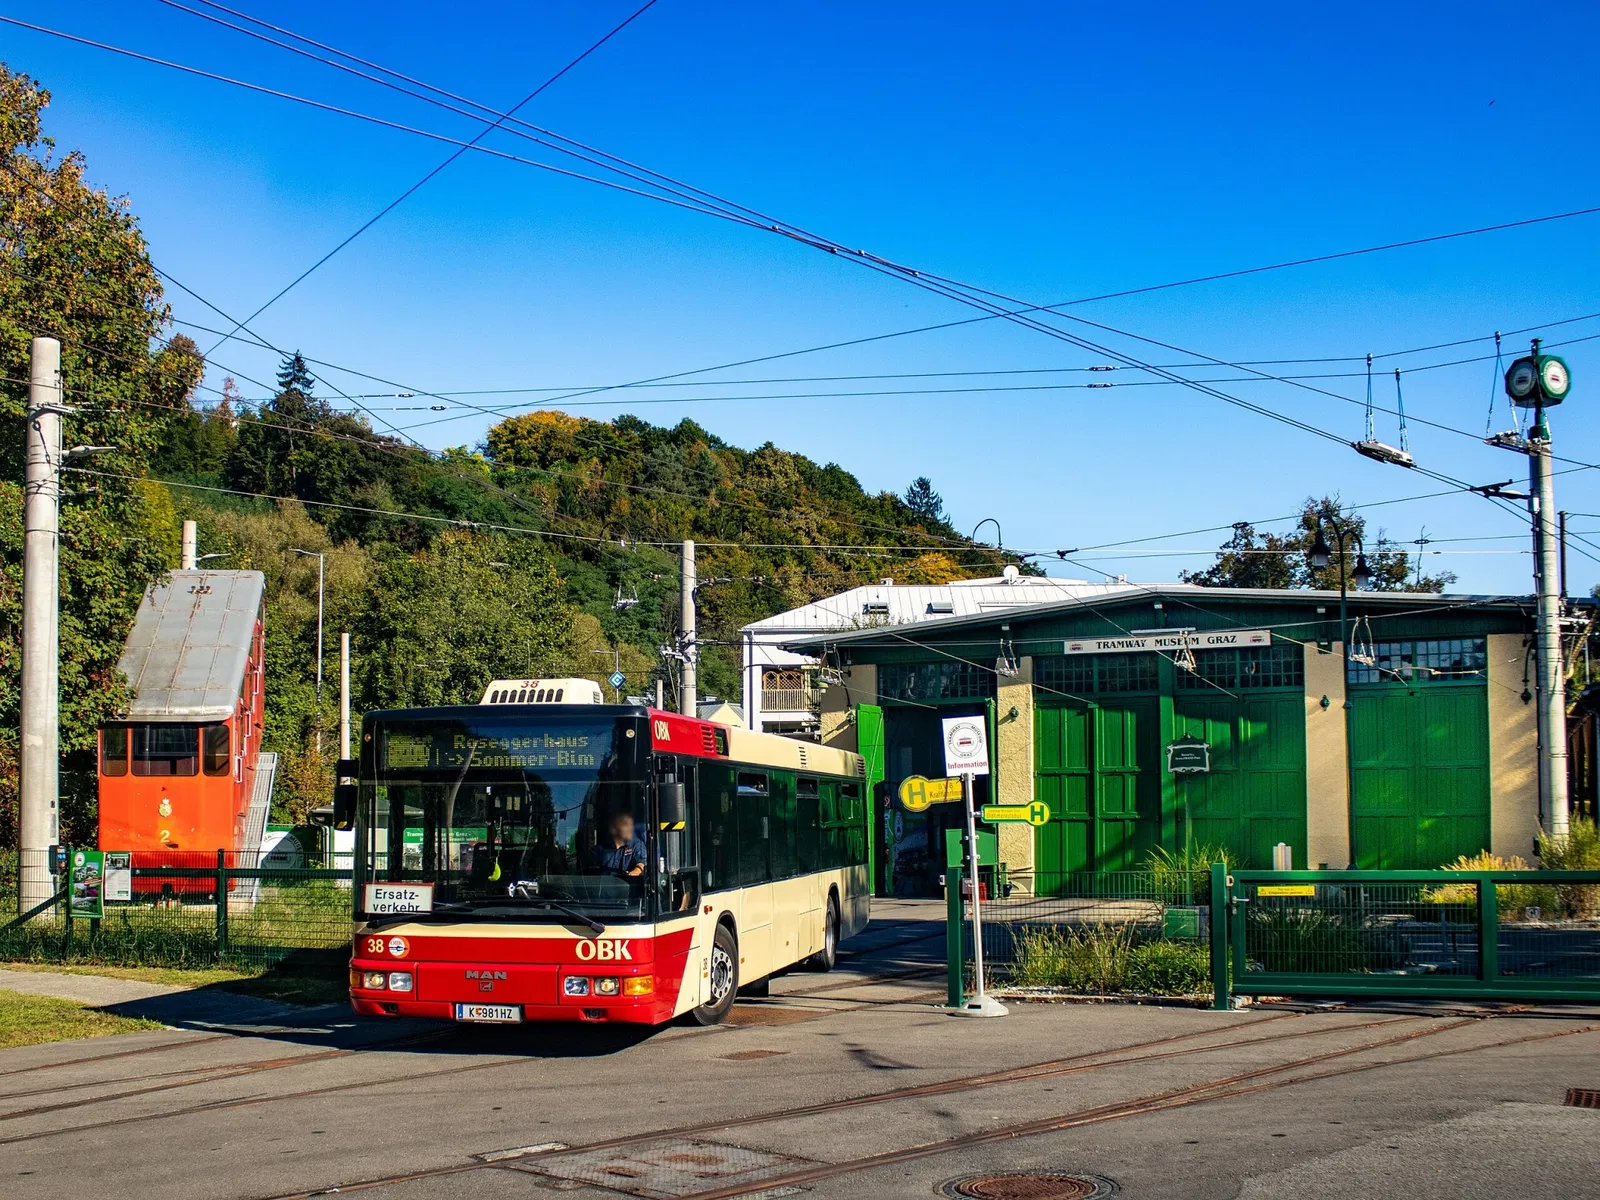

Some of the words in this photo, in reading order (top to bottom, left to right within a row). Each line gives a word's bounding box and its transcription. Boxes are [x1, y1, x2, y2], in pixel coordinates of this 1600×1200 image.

[1096, 639, 1147, 650] TRAMWAY
[1154, 636, 1200, 647] MUSEUM
[1207, 635, 1237, 645] GRAZ
[521, 680, 540, 689] 38
[654, 719, 671, 742] OBK
[453, 733, 589, 750] Roseggerhaus
[470, 750, 595, 767] Sommer-Bim
[947, 760, 988, 770] Information
[907, 781, 927, 805] H
[1030, 805, 1045, 822] H
[159, 829, 171, 843] 2
[375, 888, 420, 900] Ersatz-
[373, 901, 420, 912] verkehr
[367, 938, 385, 954] 38
[575, 939, 633, 961] OBK
[466, 970, 507, 980] MAN
